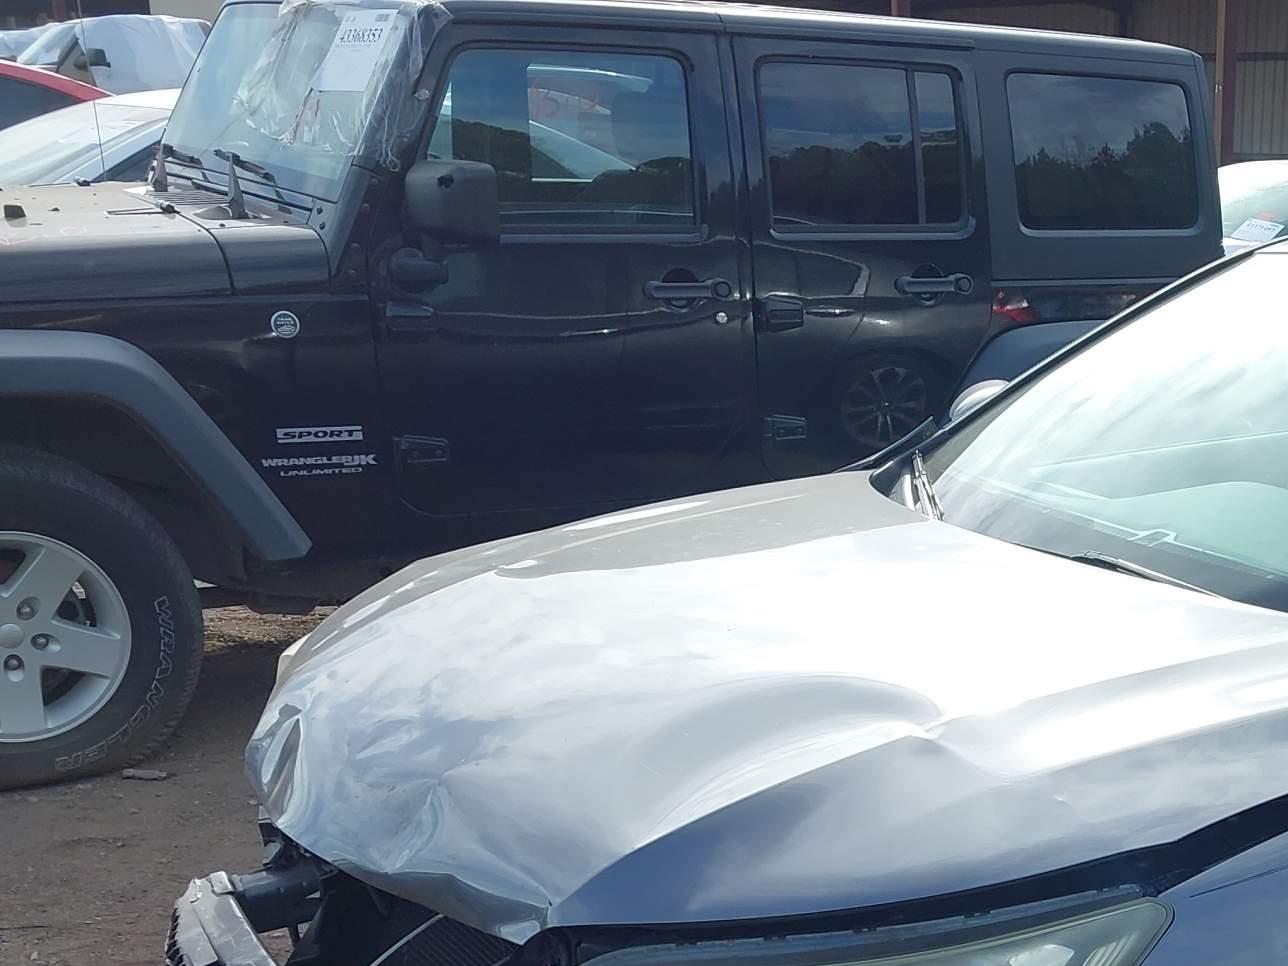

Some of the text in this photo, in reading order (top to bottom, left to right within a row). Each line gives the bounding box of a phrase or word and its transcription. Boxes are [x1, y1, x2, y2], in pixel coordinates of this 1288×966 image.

[281, 430, 355, 440] SPORT
[280, 467, 363, 477] UNLIMITED
[55, 596, 176, 772] WRANGLER
